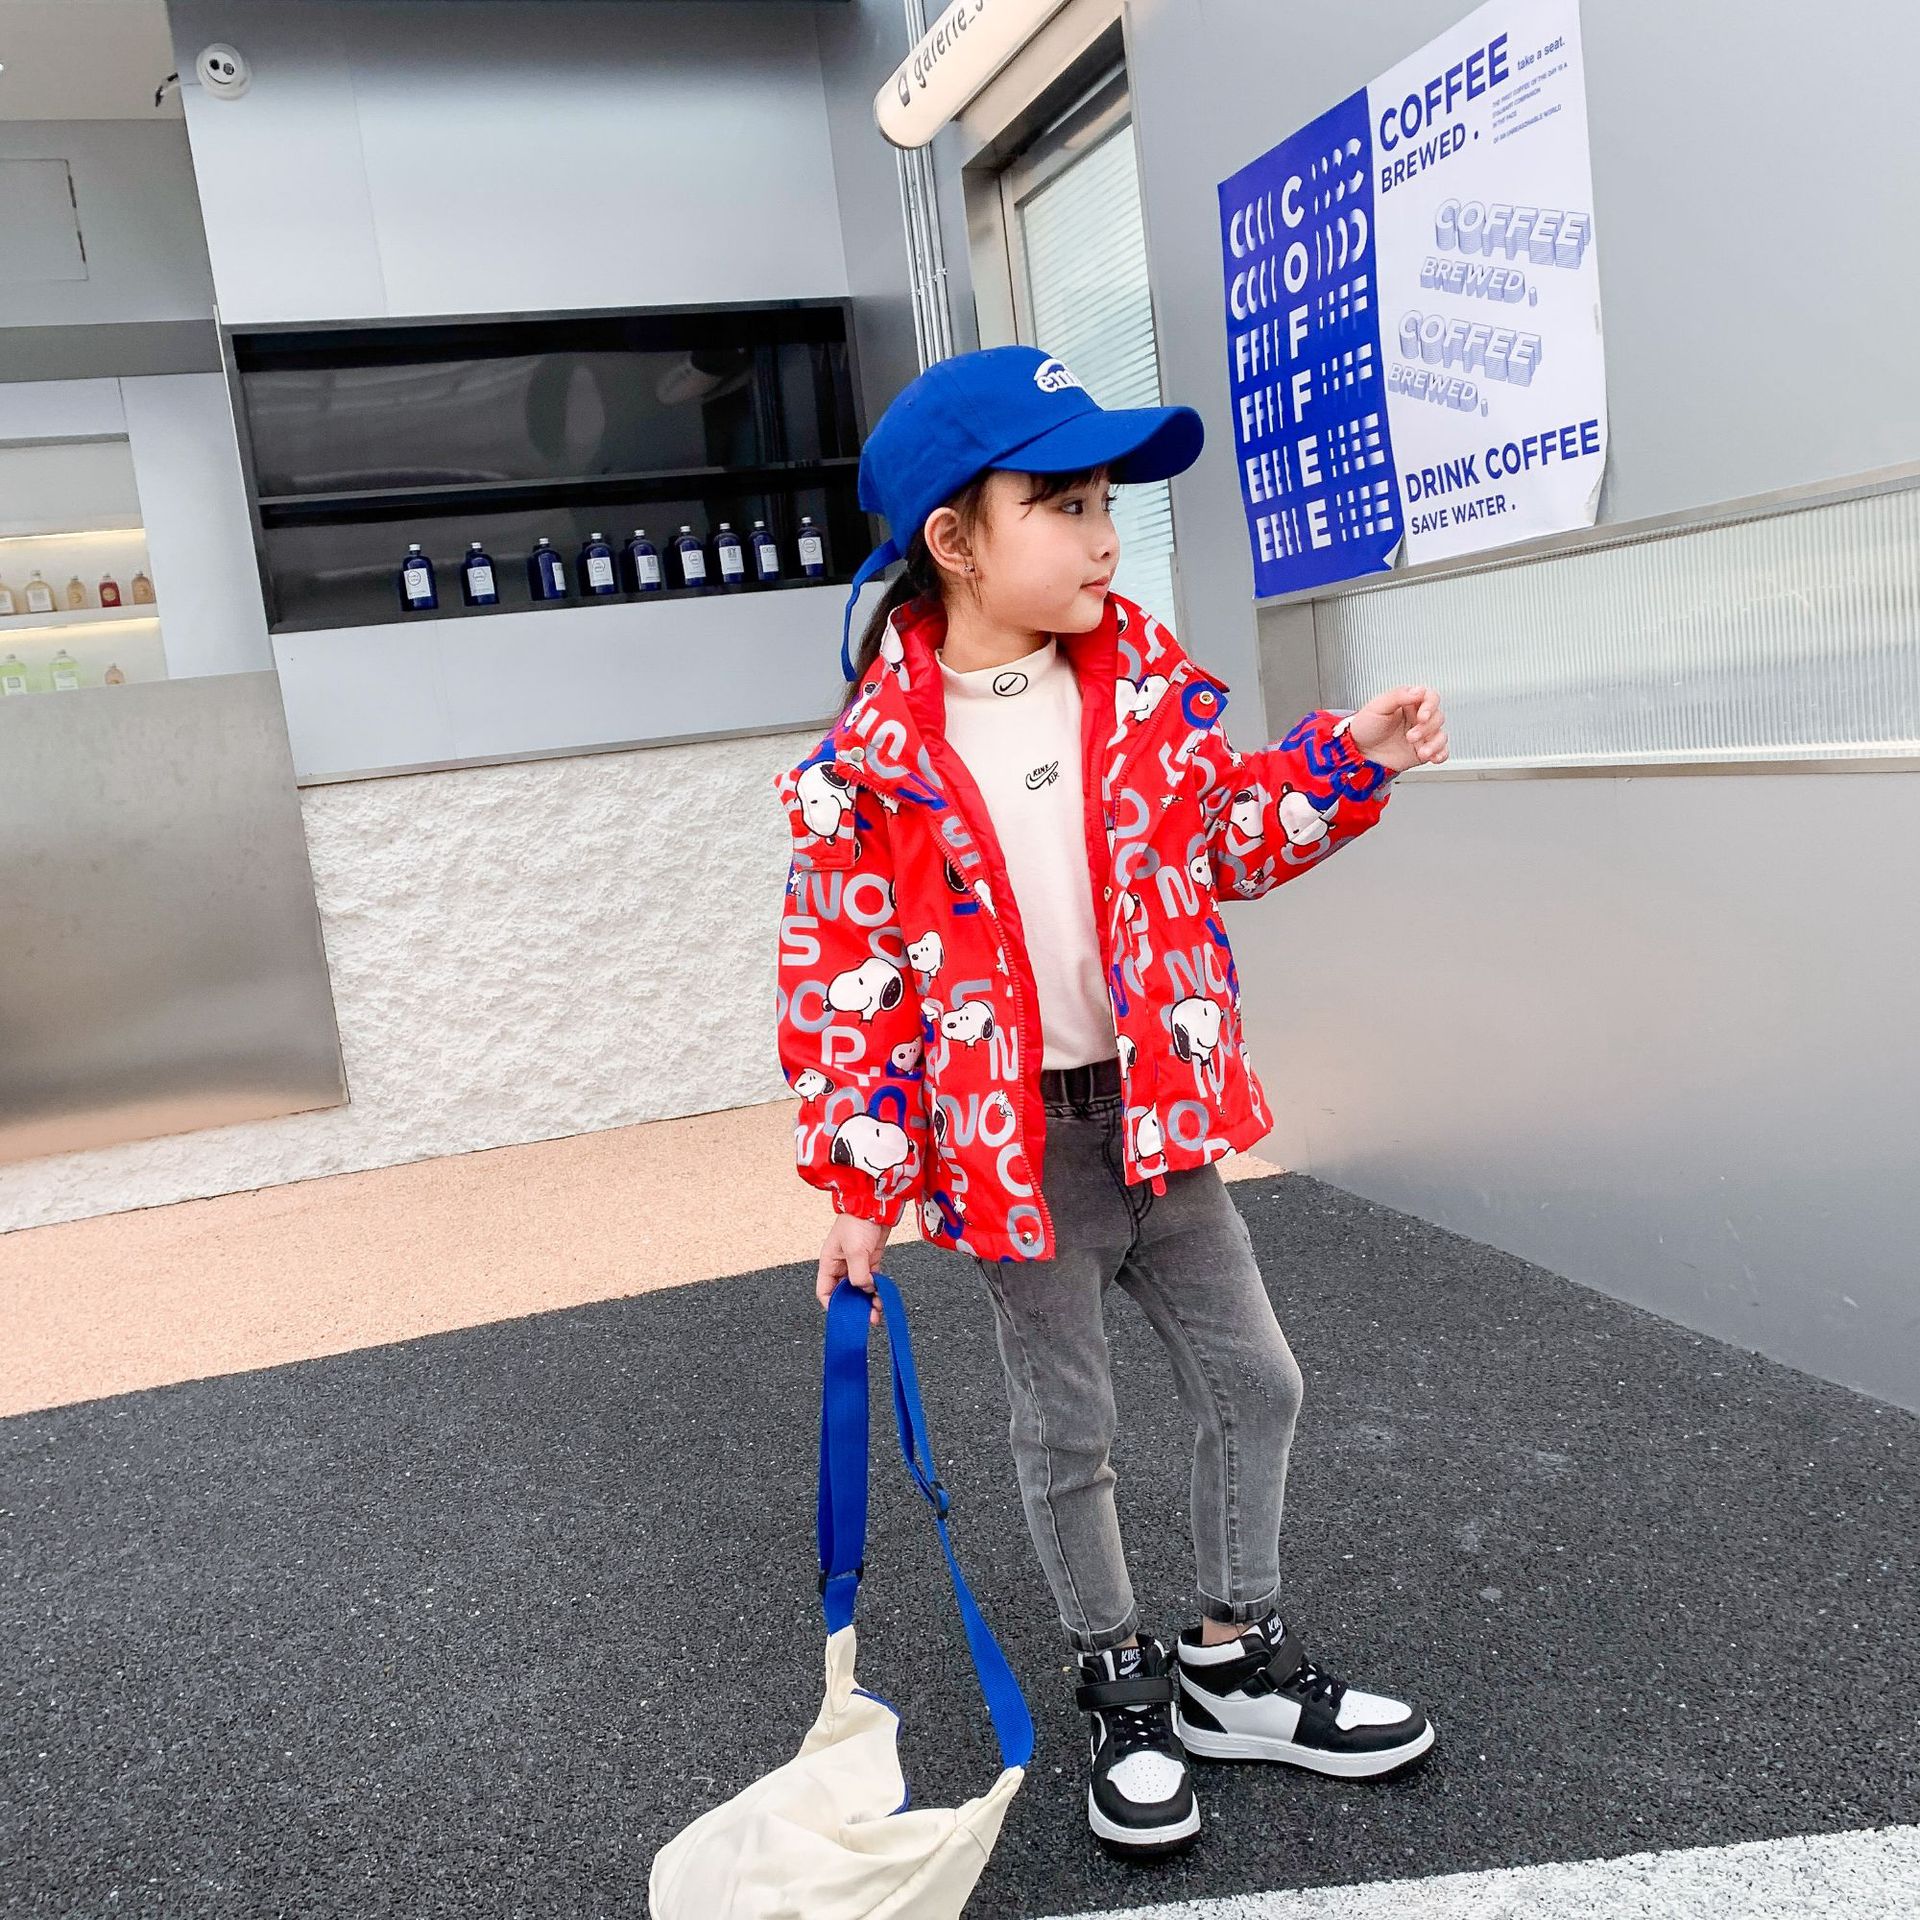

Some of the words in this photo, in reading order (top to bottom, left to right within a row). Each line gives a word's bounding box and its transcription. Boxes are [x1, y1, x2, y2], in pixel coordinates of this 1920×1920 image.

[1517, 54, 1535, 71] take
[1537, 50, 1542, 60] a
[1544, 36, 1566, 55] seat.
[1380, 32, 1509, 151] COFFEE
[1435, 198, 1591, 269] COFFEE
[1398, 310, 1542, 387] COFFEE
[1405, 454, 1480, 503] DRINK
[1485, 419, 1600, 480] COFFEE
[1411, 509, 1448, 535] SAVE
